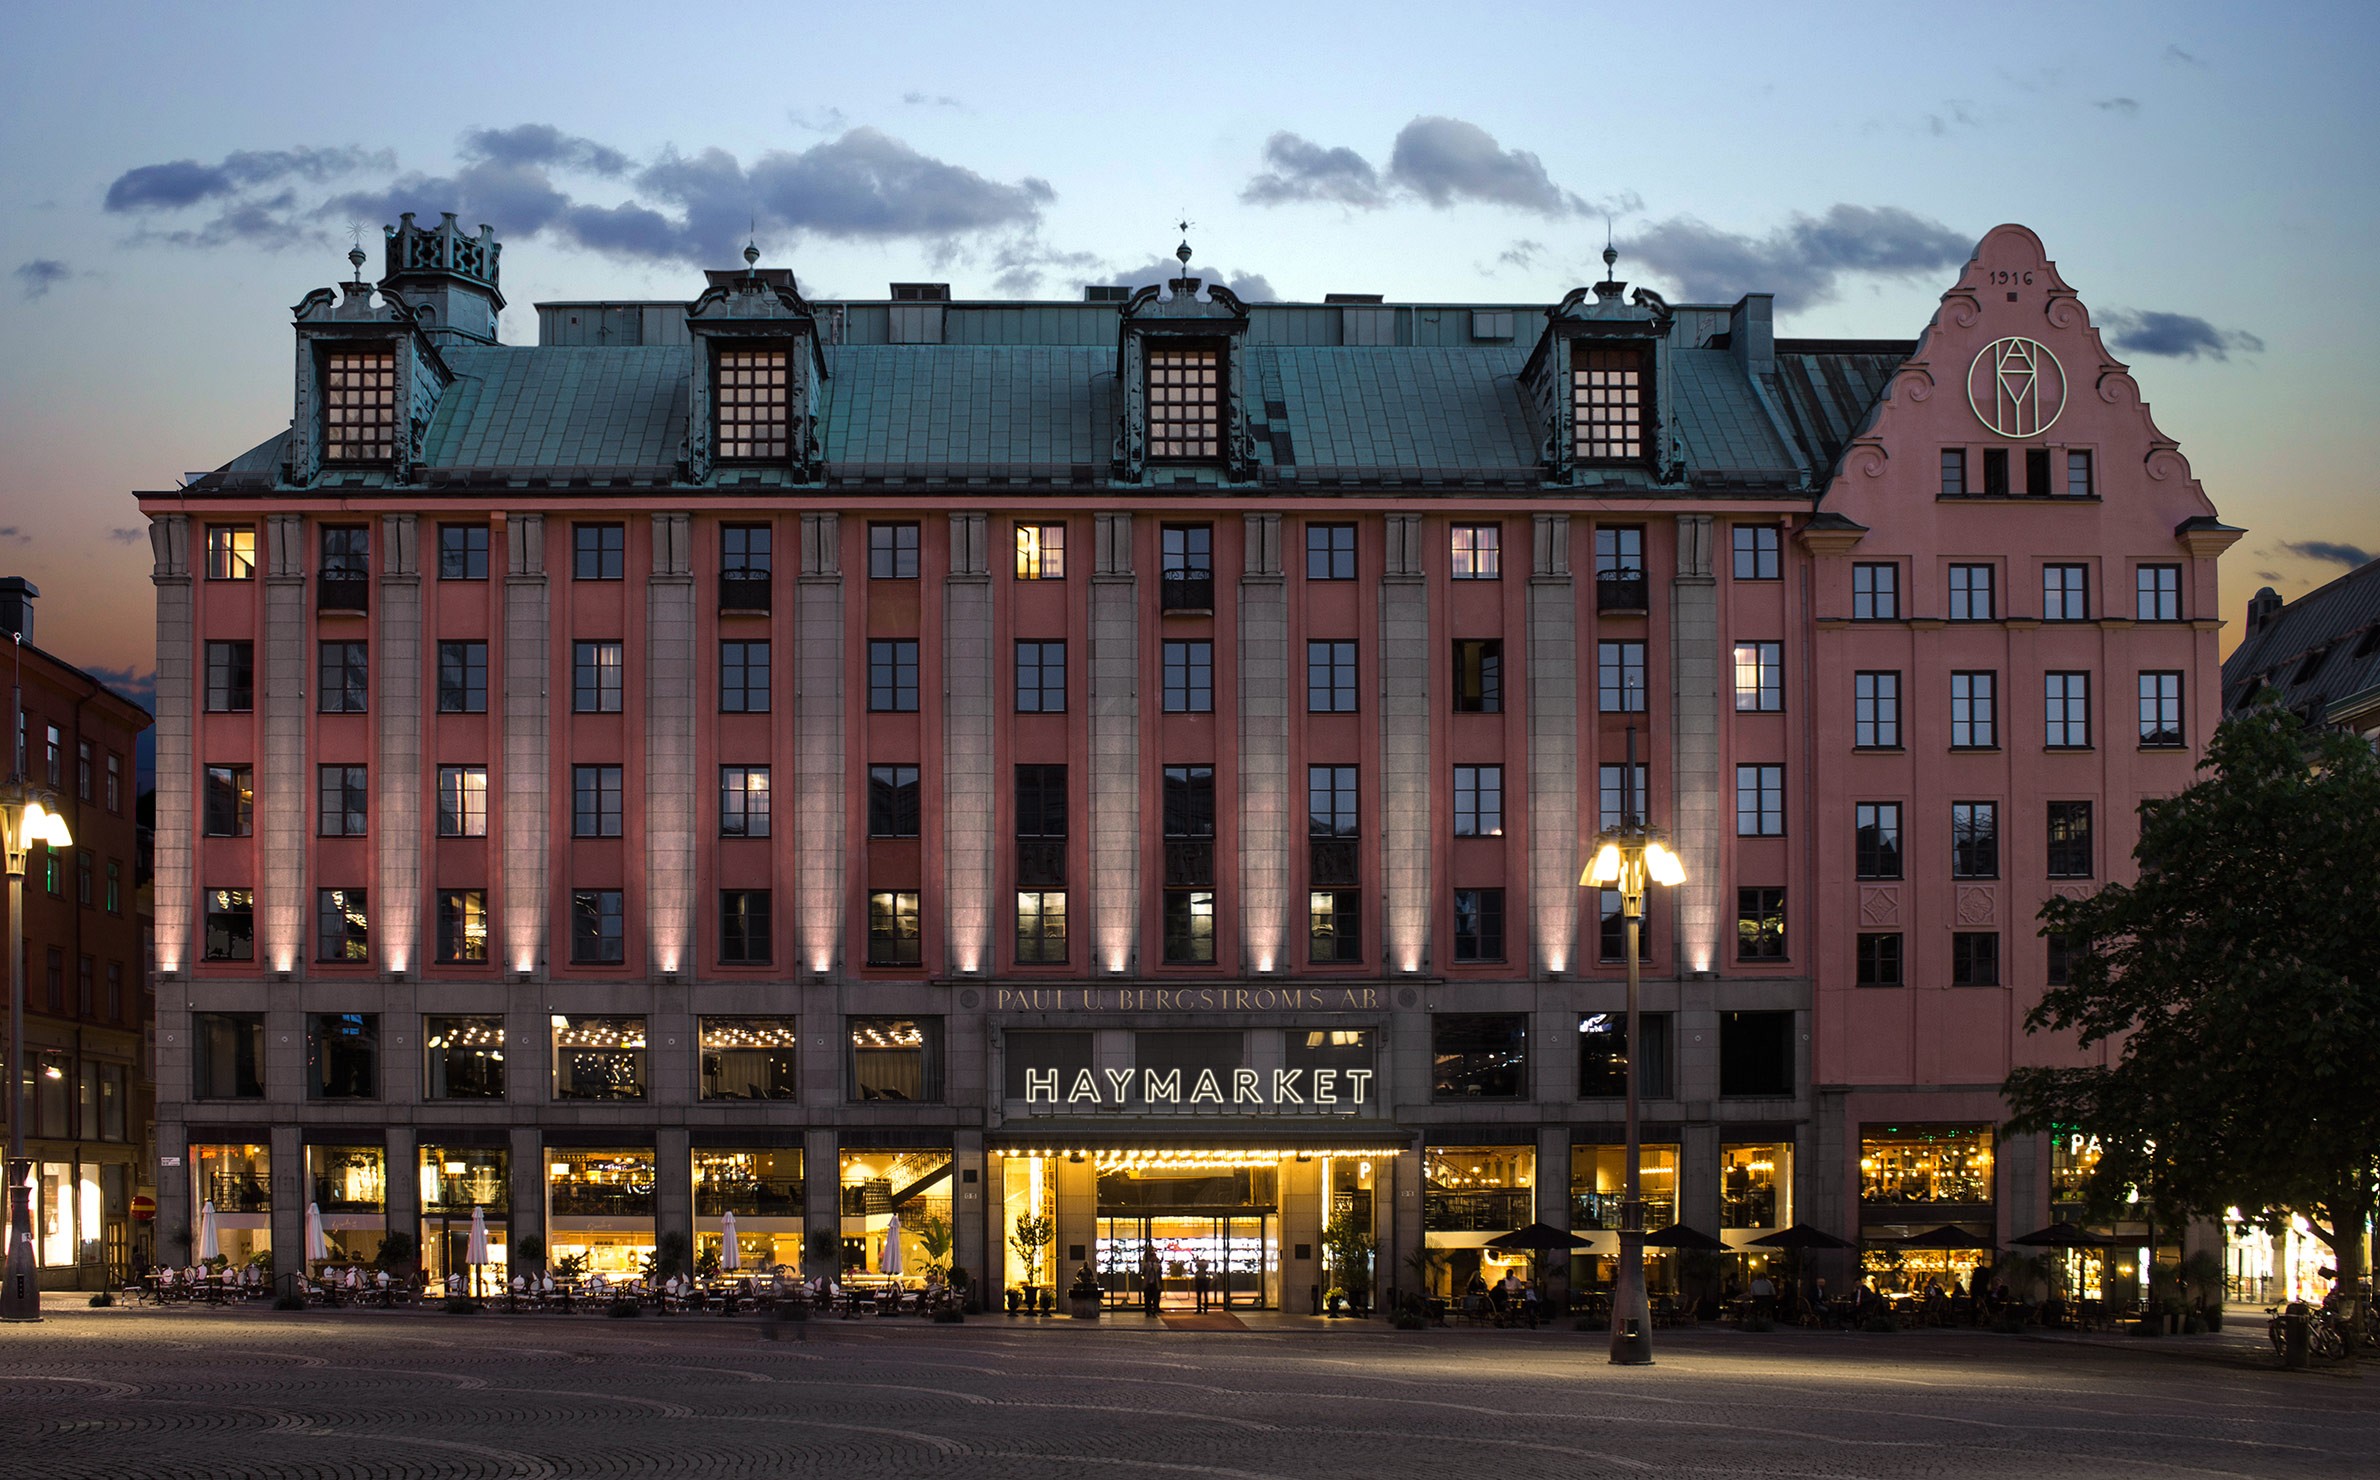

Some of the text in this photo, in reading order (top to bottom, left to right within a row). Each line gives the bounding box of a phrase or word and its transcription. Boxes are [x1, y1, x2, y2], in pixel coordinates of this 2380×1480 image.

[1990, 271, 2033, 286] 1916
[999, 989, 1069, 1010] PAUL
[1083, 989, 1104, 1010] U.
[1120, 987, 1324, 1010] BERGSTRÖMS
[1026, 1069, 1372, 1103] HAYMARKET
